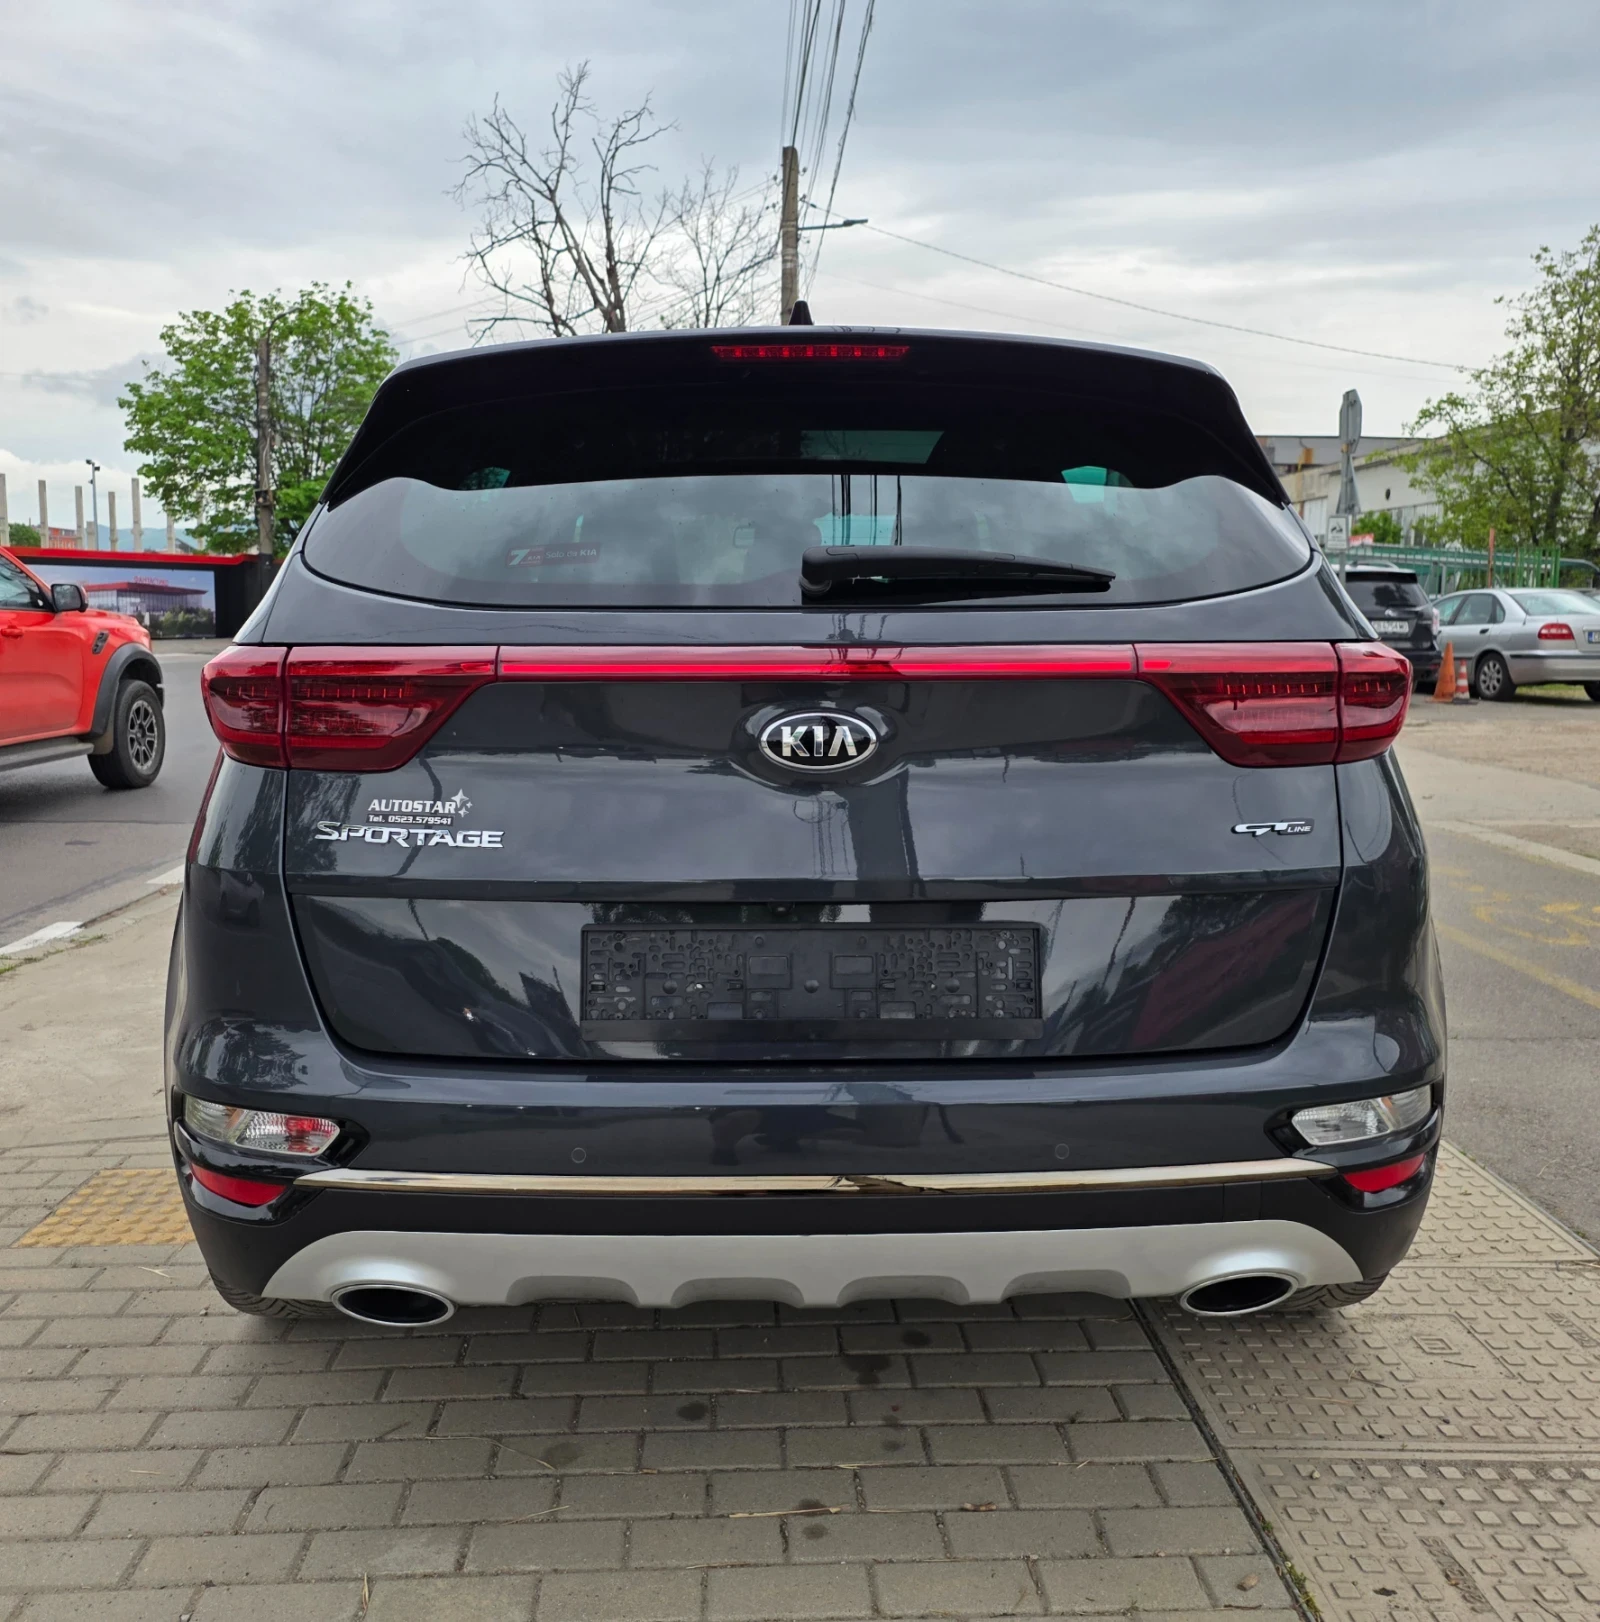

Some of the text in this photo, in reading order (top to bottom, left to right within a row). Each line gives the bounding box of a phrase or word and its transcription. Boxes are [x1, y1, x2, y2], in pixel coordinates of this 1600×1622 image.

[579, 548, 597, 556] KIA
[781, 725, 858, 757] KIA
[367, 798, 456, 814] AUTOSTAR
[368, 814, 452, 825] Tel. 0523.579541
[314, 820, 505, 848] SPORTAGE
[1287, 825, 1312, 833] LINE
